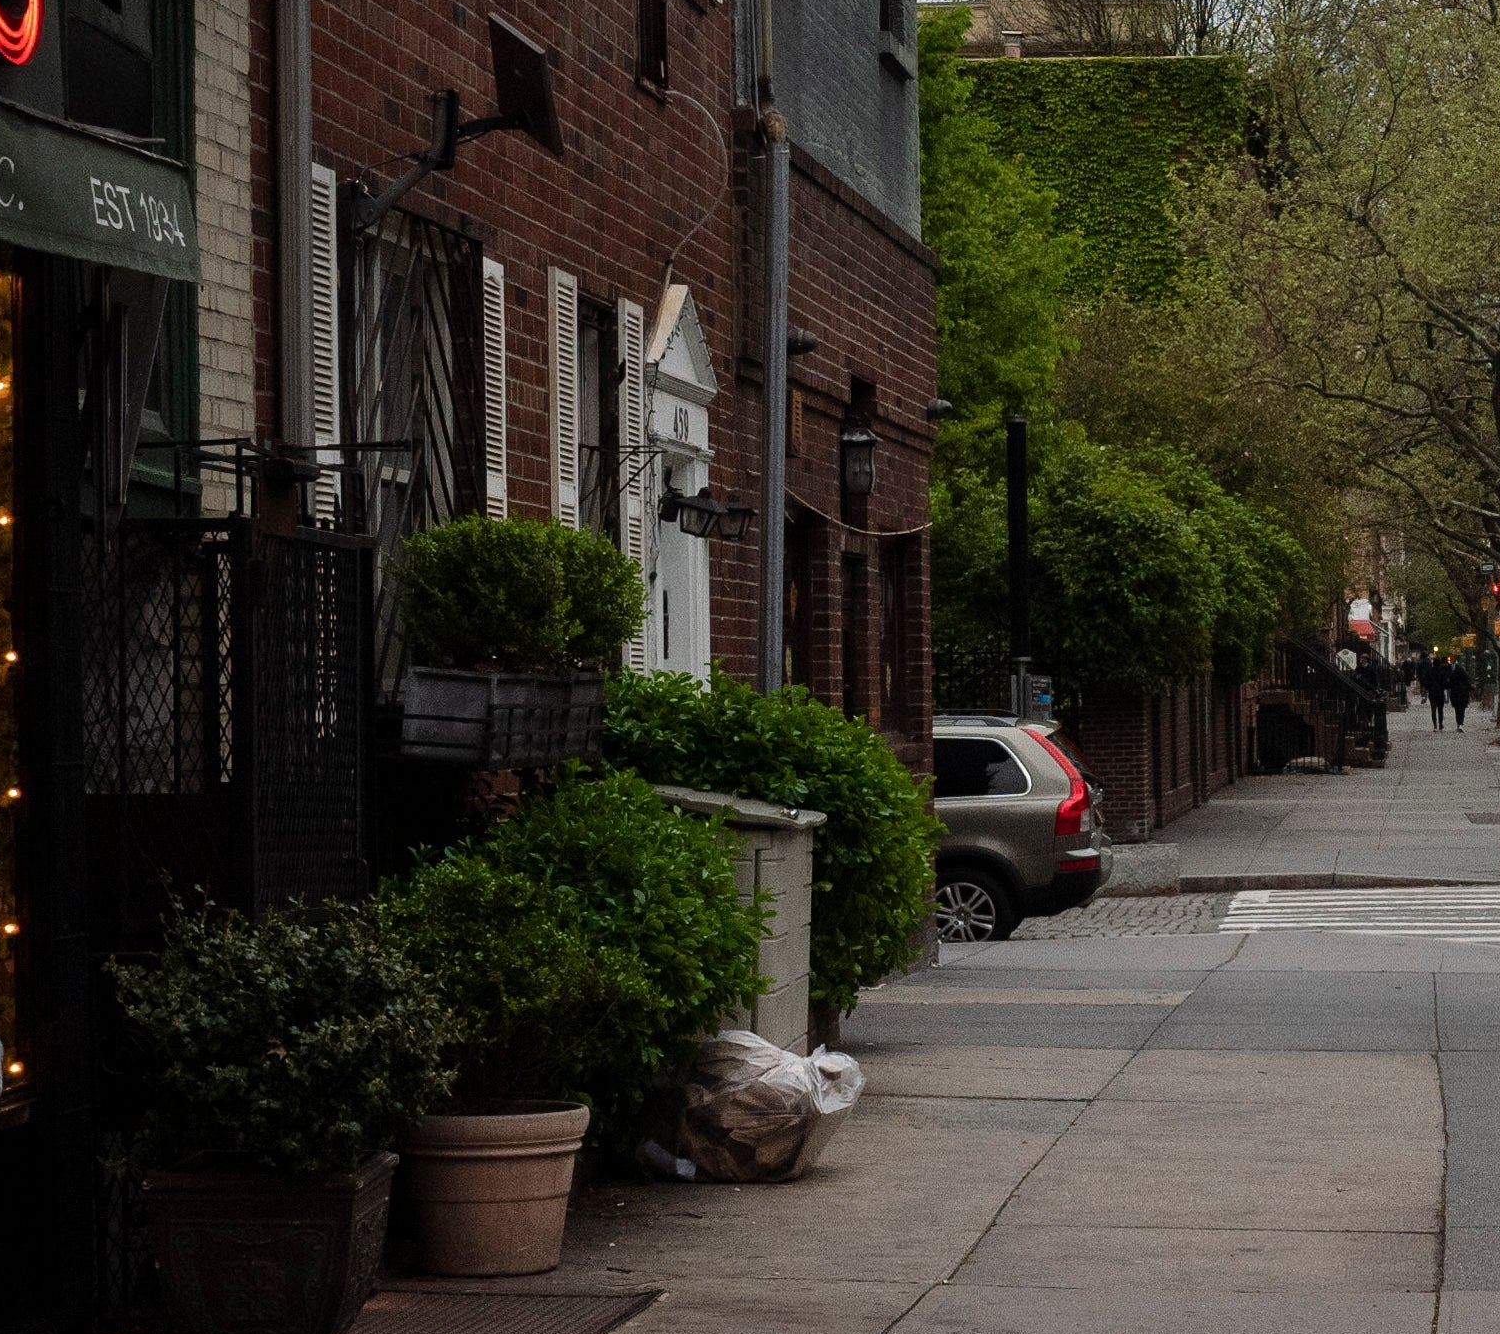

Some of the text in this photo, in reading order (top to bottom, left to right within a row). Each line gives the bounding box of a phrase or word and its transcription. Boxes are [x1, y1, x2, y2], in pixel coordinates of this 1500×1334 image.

[90, 177, 185, 247] EST 1934
[673, 405, 689, 442] 459
